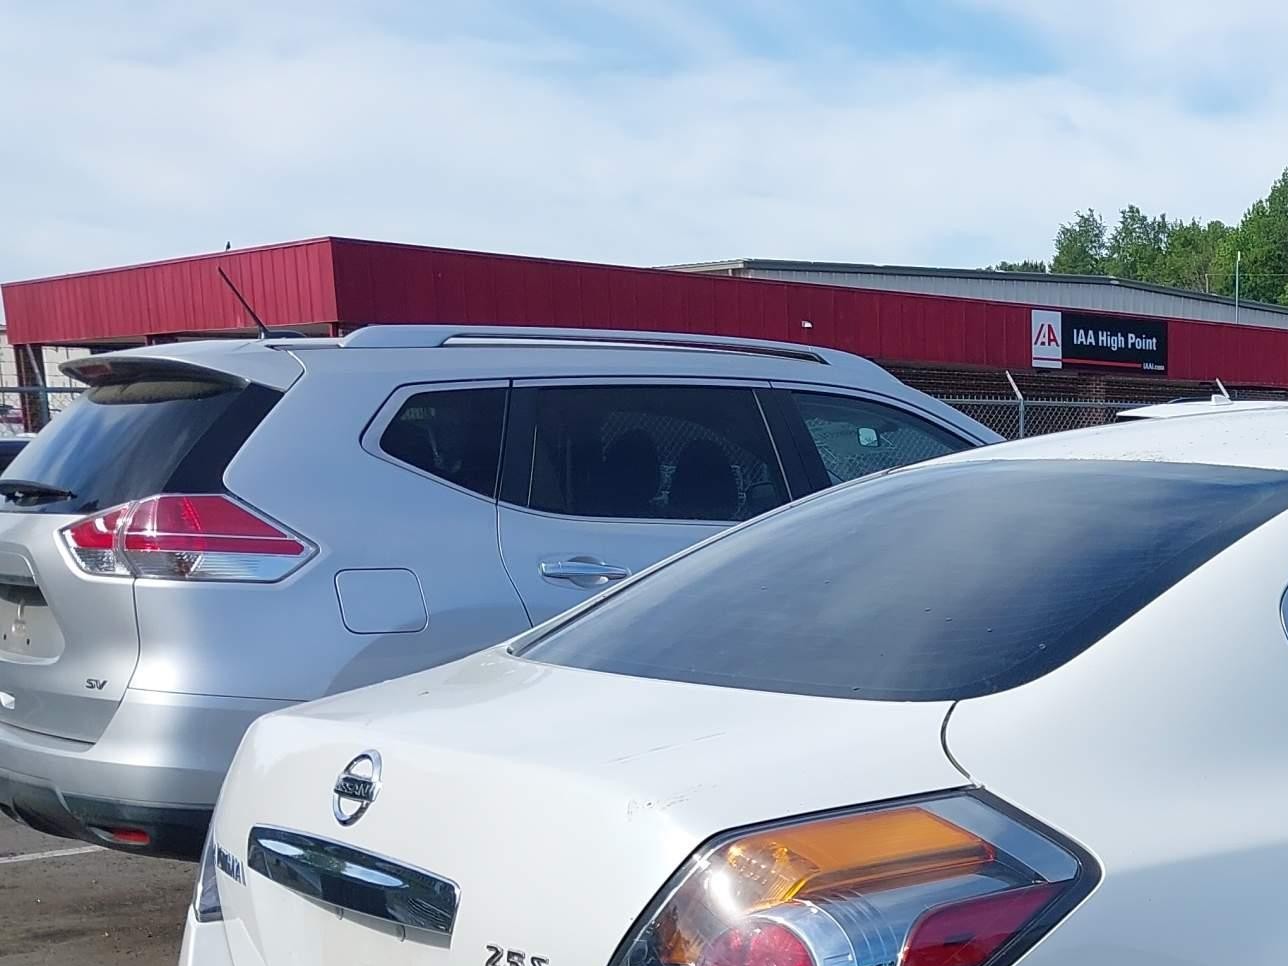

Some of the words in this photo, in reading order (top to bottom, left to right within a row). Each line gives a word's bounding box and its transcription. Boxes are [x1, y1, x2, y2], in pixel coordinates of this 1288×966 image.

[1073, 329, 1096, 346] IAA
[1098, 330, 1126, 351] High
[1128, 332, 1157, 352] Point
[86, 678, 107, 690] SV
